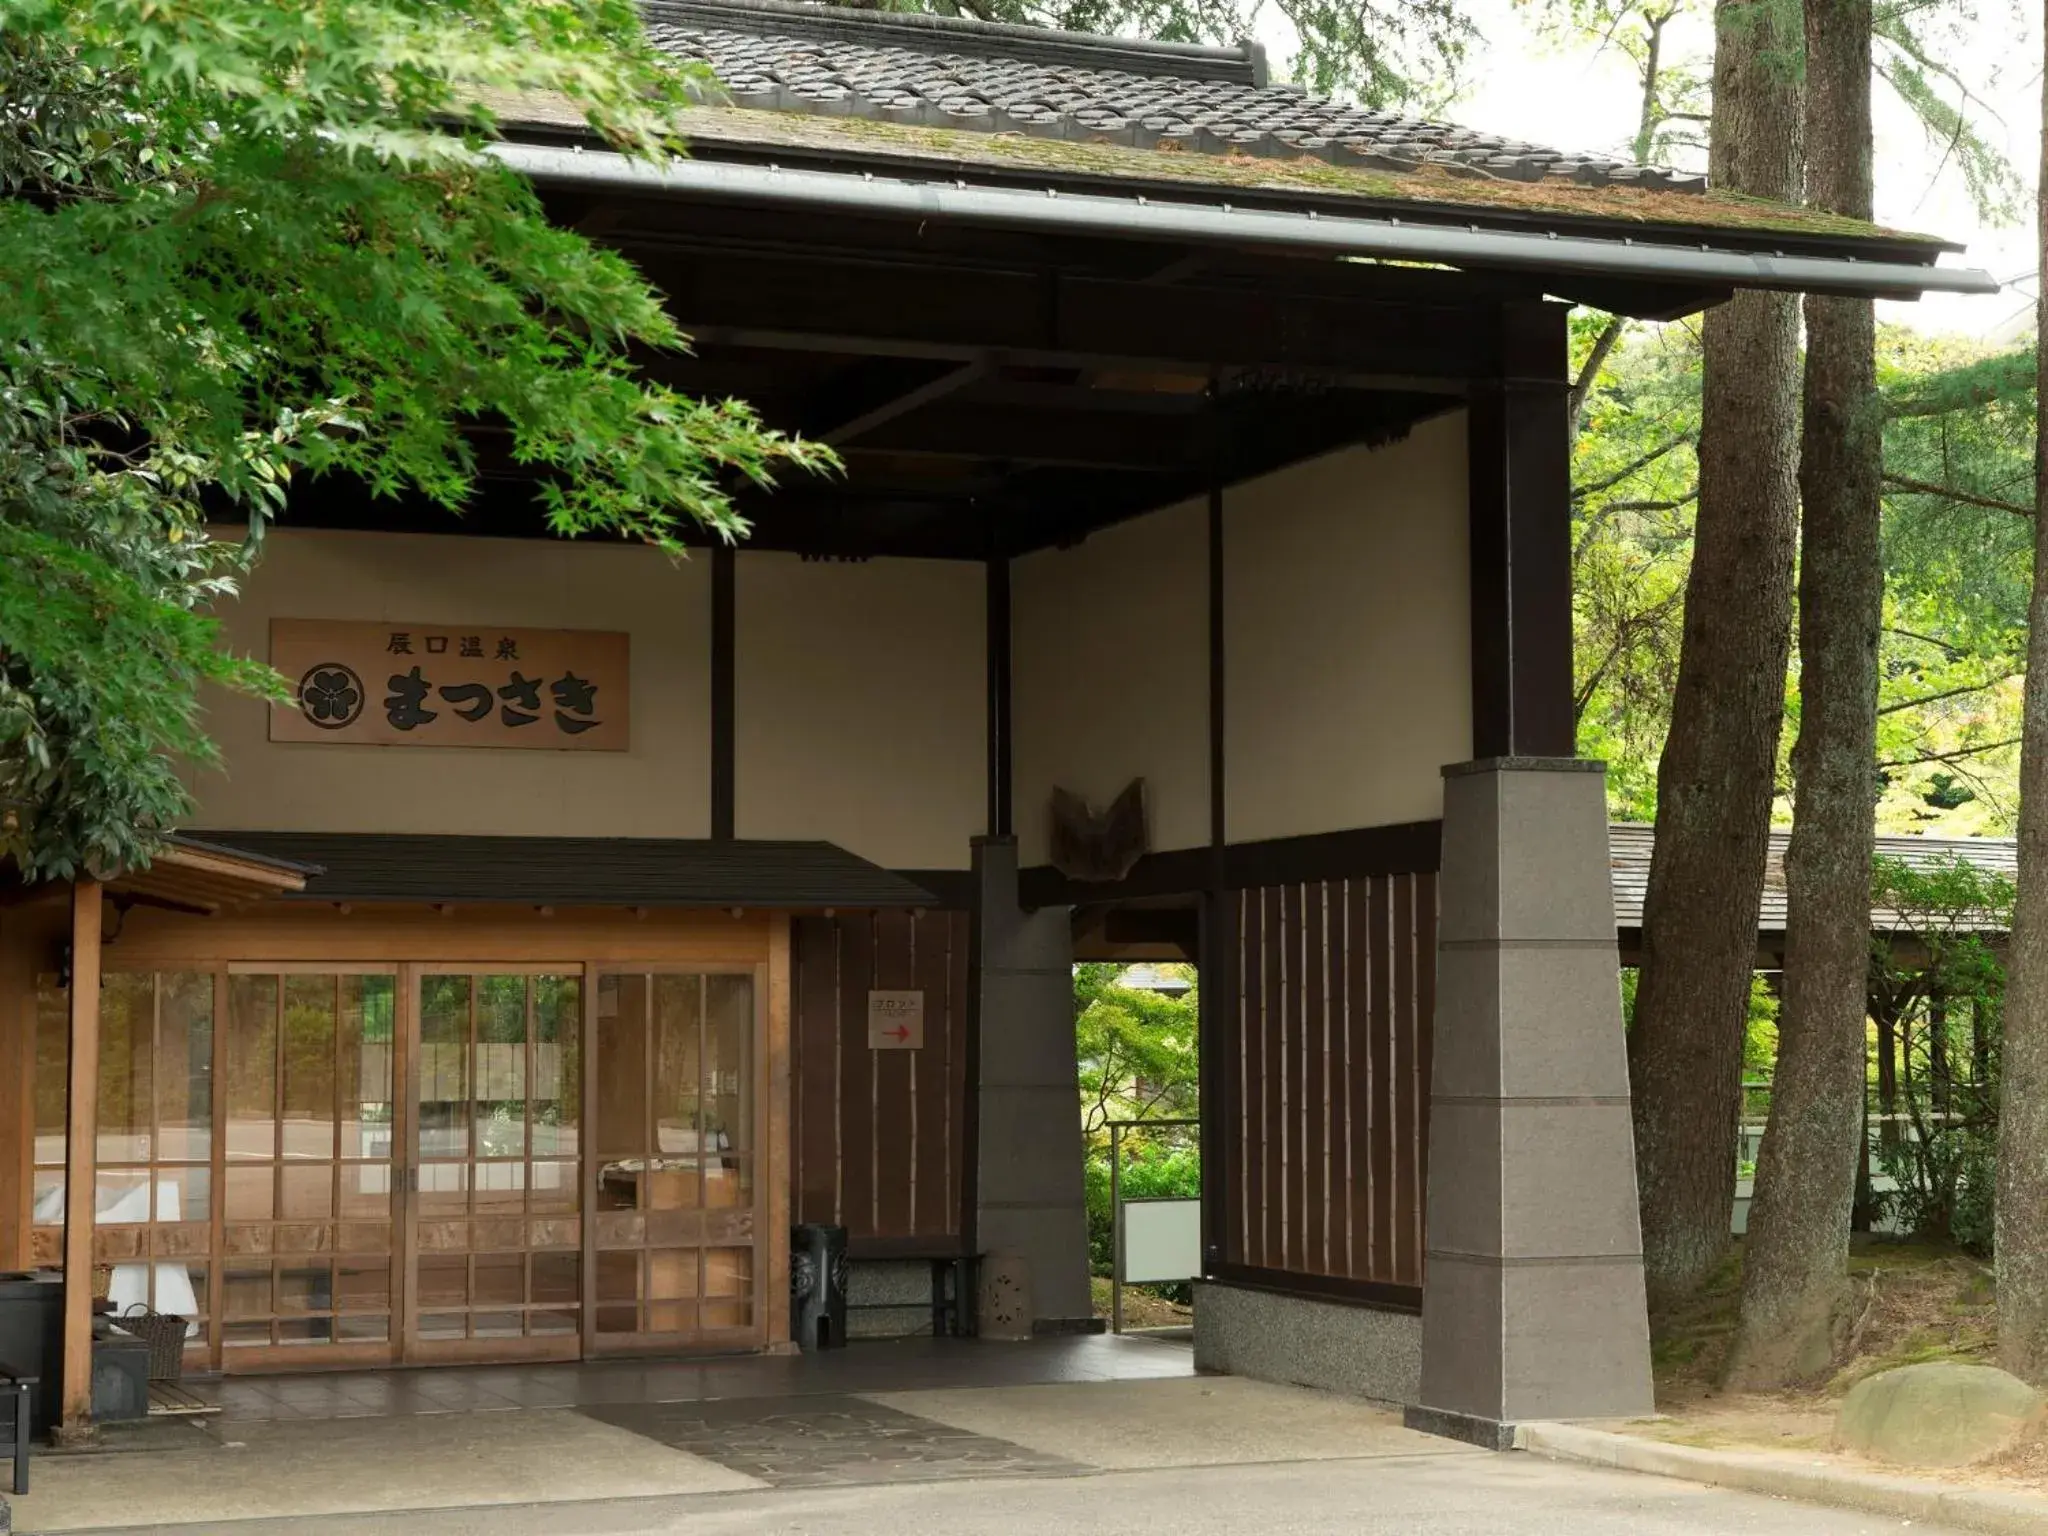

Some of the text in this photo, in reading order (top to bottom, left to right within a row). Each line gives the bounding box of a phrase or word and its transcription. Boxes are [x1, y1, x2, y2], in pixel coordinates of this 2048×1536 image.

[386, 632, 520, 660] 辰口温泉
[383, 666, 603, 734] まつさき
